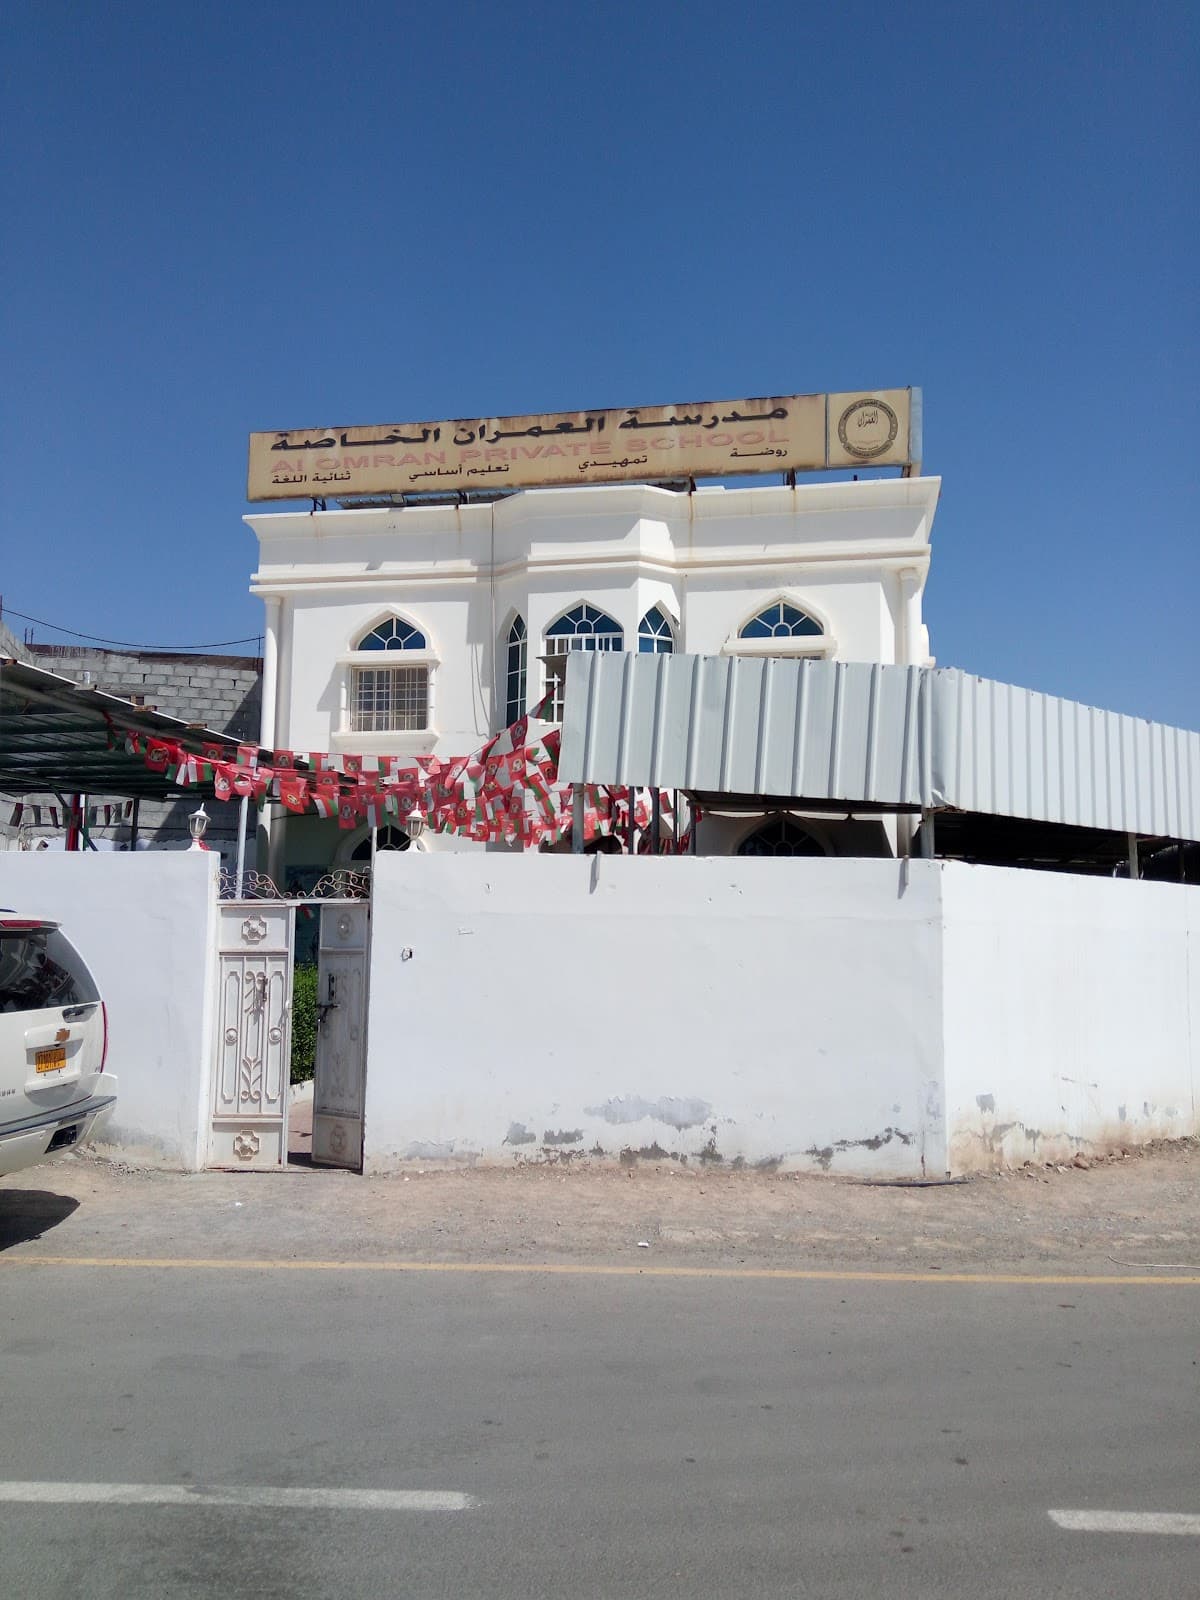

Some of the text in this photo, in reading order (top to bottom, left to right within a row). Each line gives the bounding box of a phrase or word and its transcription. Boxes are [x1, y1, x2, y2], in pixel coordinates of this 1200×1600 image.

[270, 407, 789, 451] مدرسة العمران الخاصة
[315, 451, 446, 470] OMRAN
[460, 441, 612, 463] PRIVATE
[625, 430, 790, 453] SCHOOL
[730, 447, 788, 458] روضة
[408, 464, 510, 482] تعليم أساسي
[578, 455, 648, 473] تمهيدي
[272, 471, 351, 484] ثنائية اللغة
